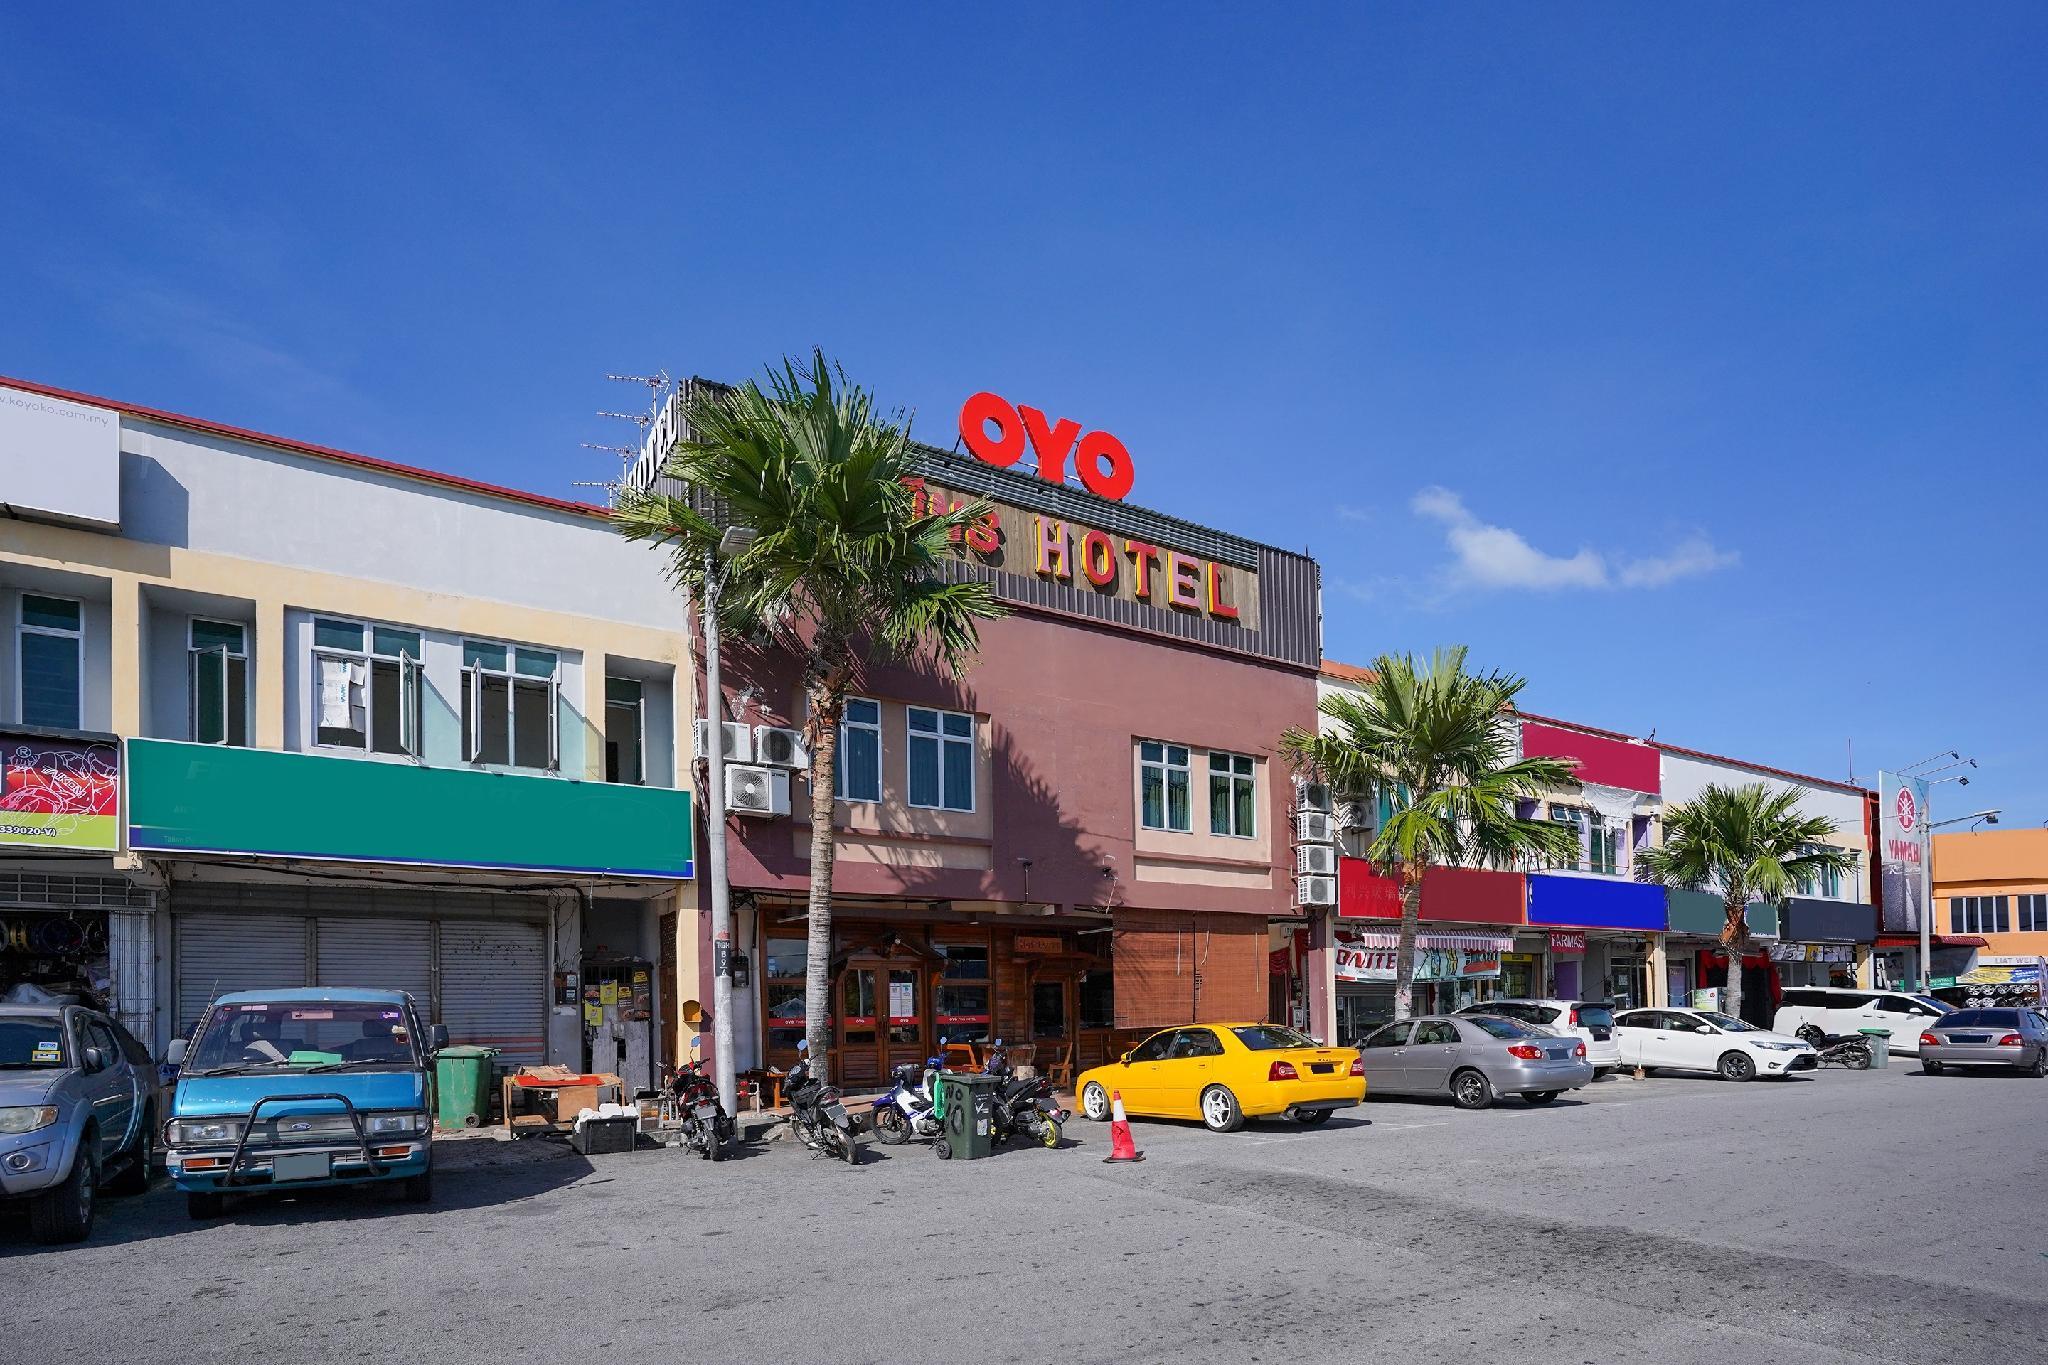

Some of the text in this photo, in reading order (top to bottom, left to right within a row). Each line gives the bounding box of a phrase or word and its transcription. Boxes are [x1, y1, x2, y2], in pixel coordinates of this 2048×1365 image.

[958, 391, 1135, 501] OYO
[1034, 515, 1239, 620] HOTEL
[1888, 839, 1921, 863] YAMAH
[1551, 934, 1585, 949] FARMASI
